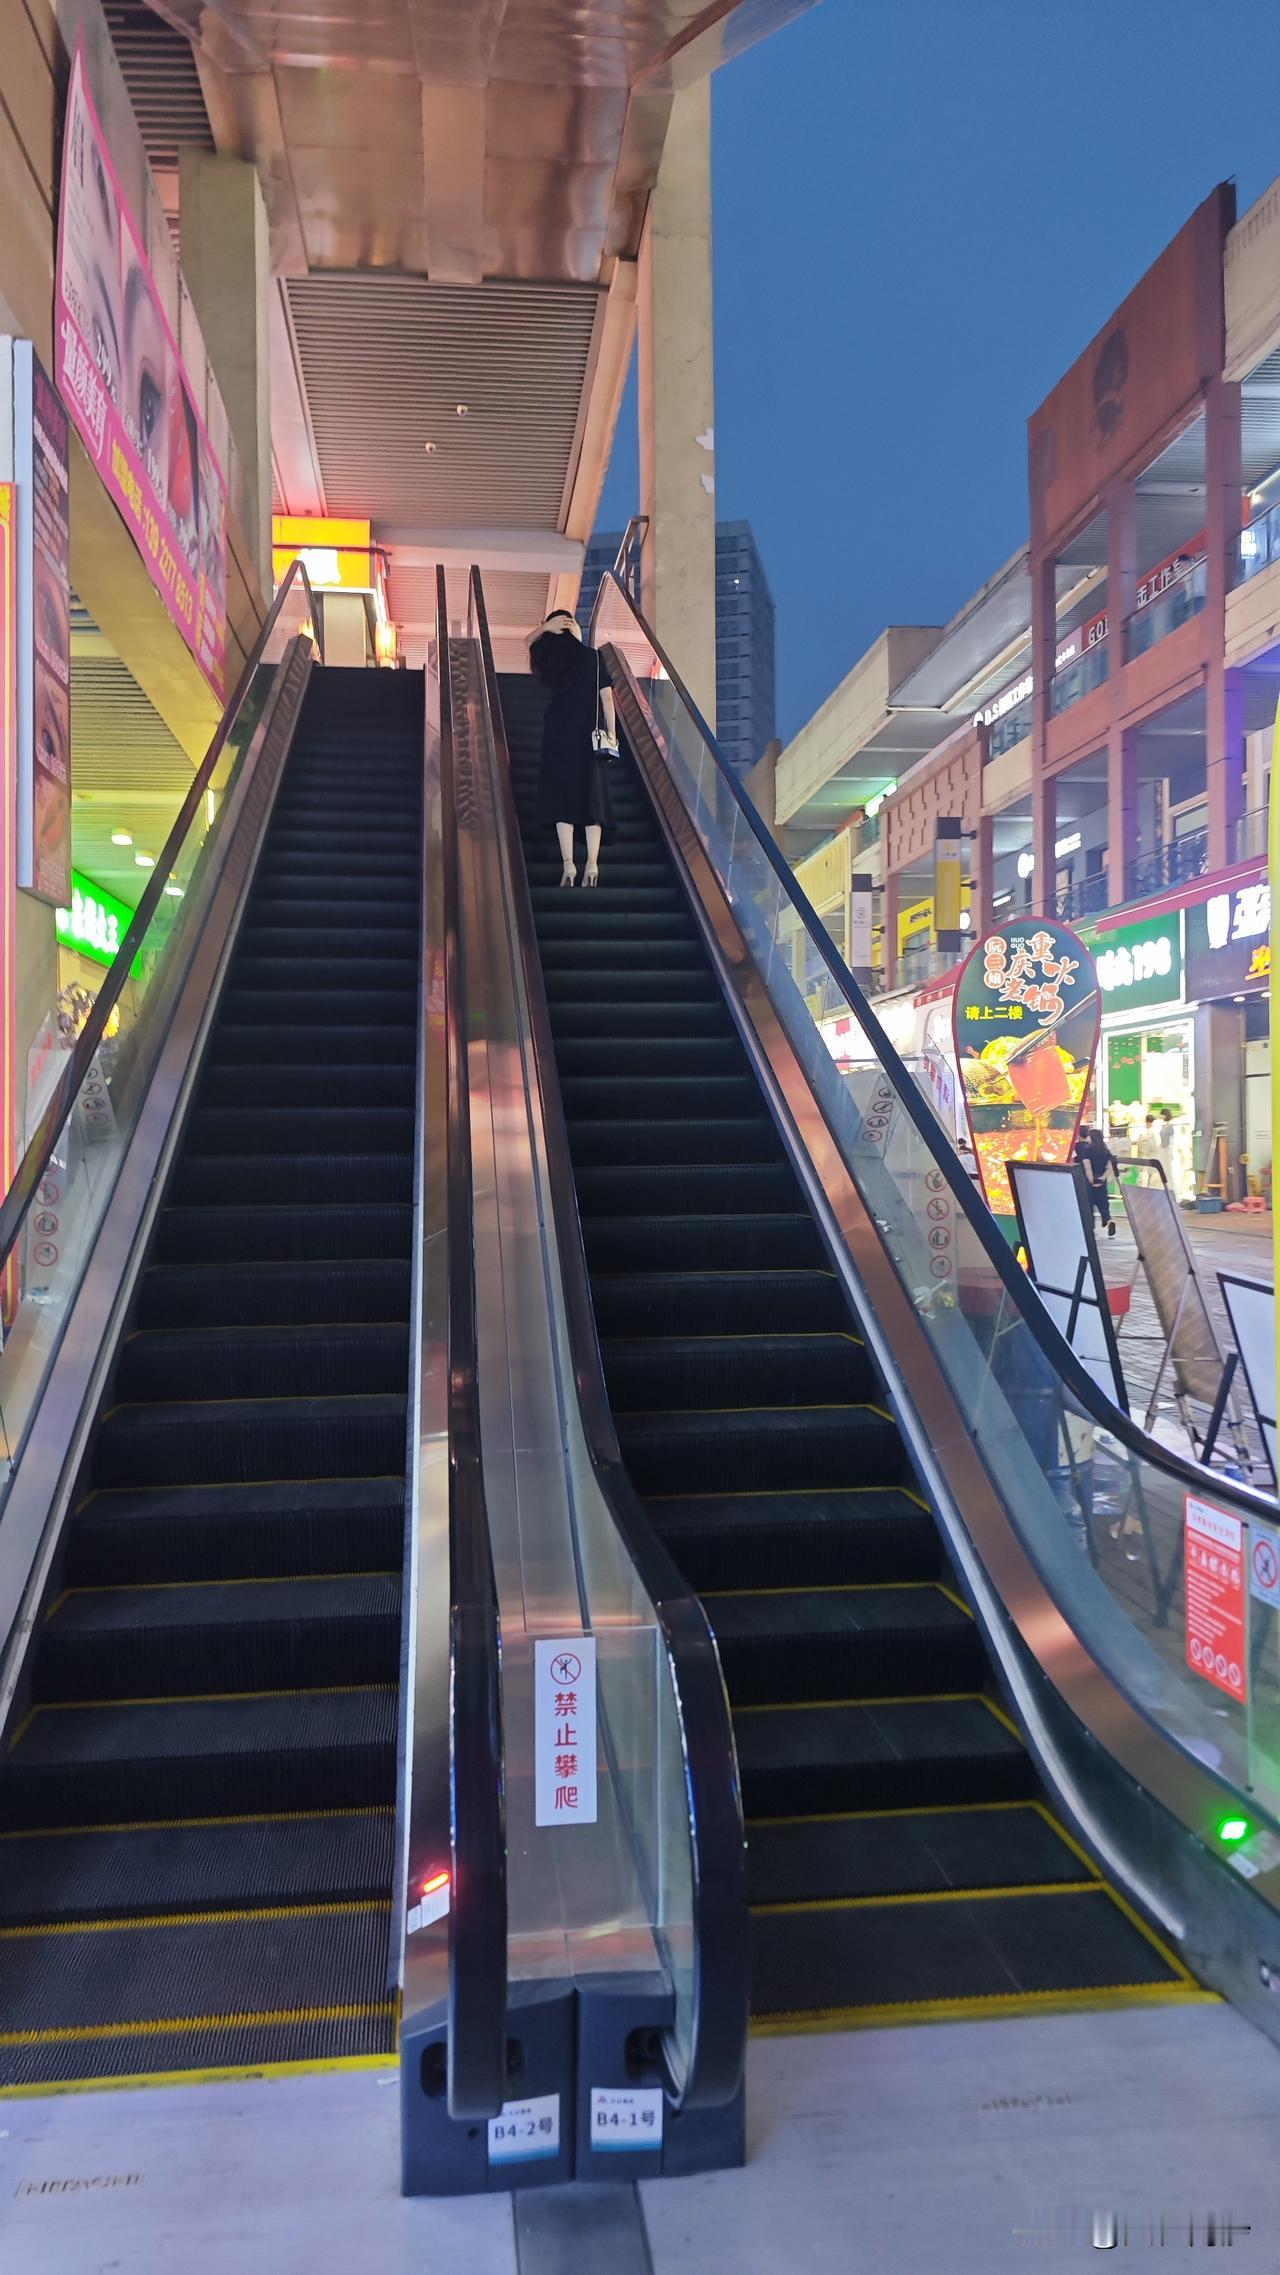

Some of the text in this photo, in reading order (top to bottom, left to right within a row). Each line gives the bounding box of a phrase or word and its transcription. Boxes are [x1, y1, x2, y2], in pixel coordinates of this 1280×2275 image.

[965, 1005, 1024, 1021] 请上二楼
[554, 1691, 579, 1810] 禁止攀爬
[495, 2117, 552, 2139] B4-2号
[597, 2110, 655, 2127] B4-1号
